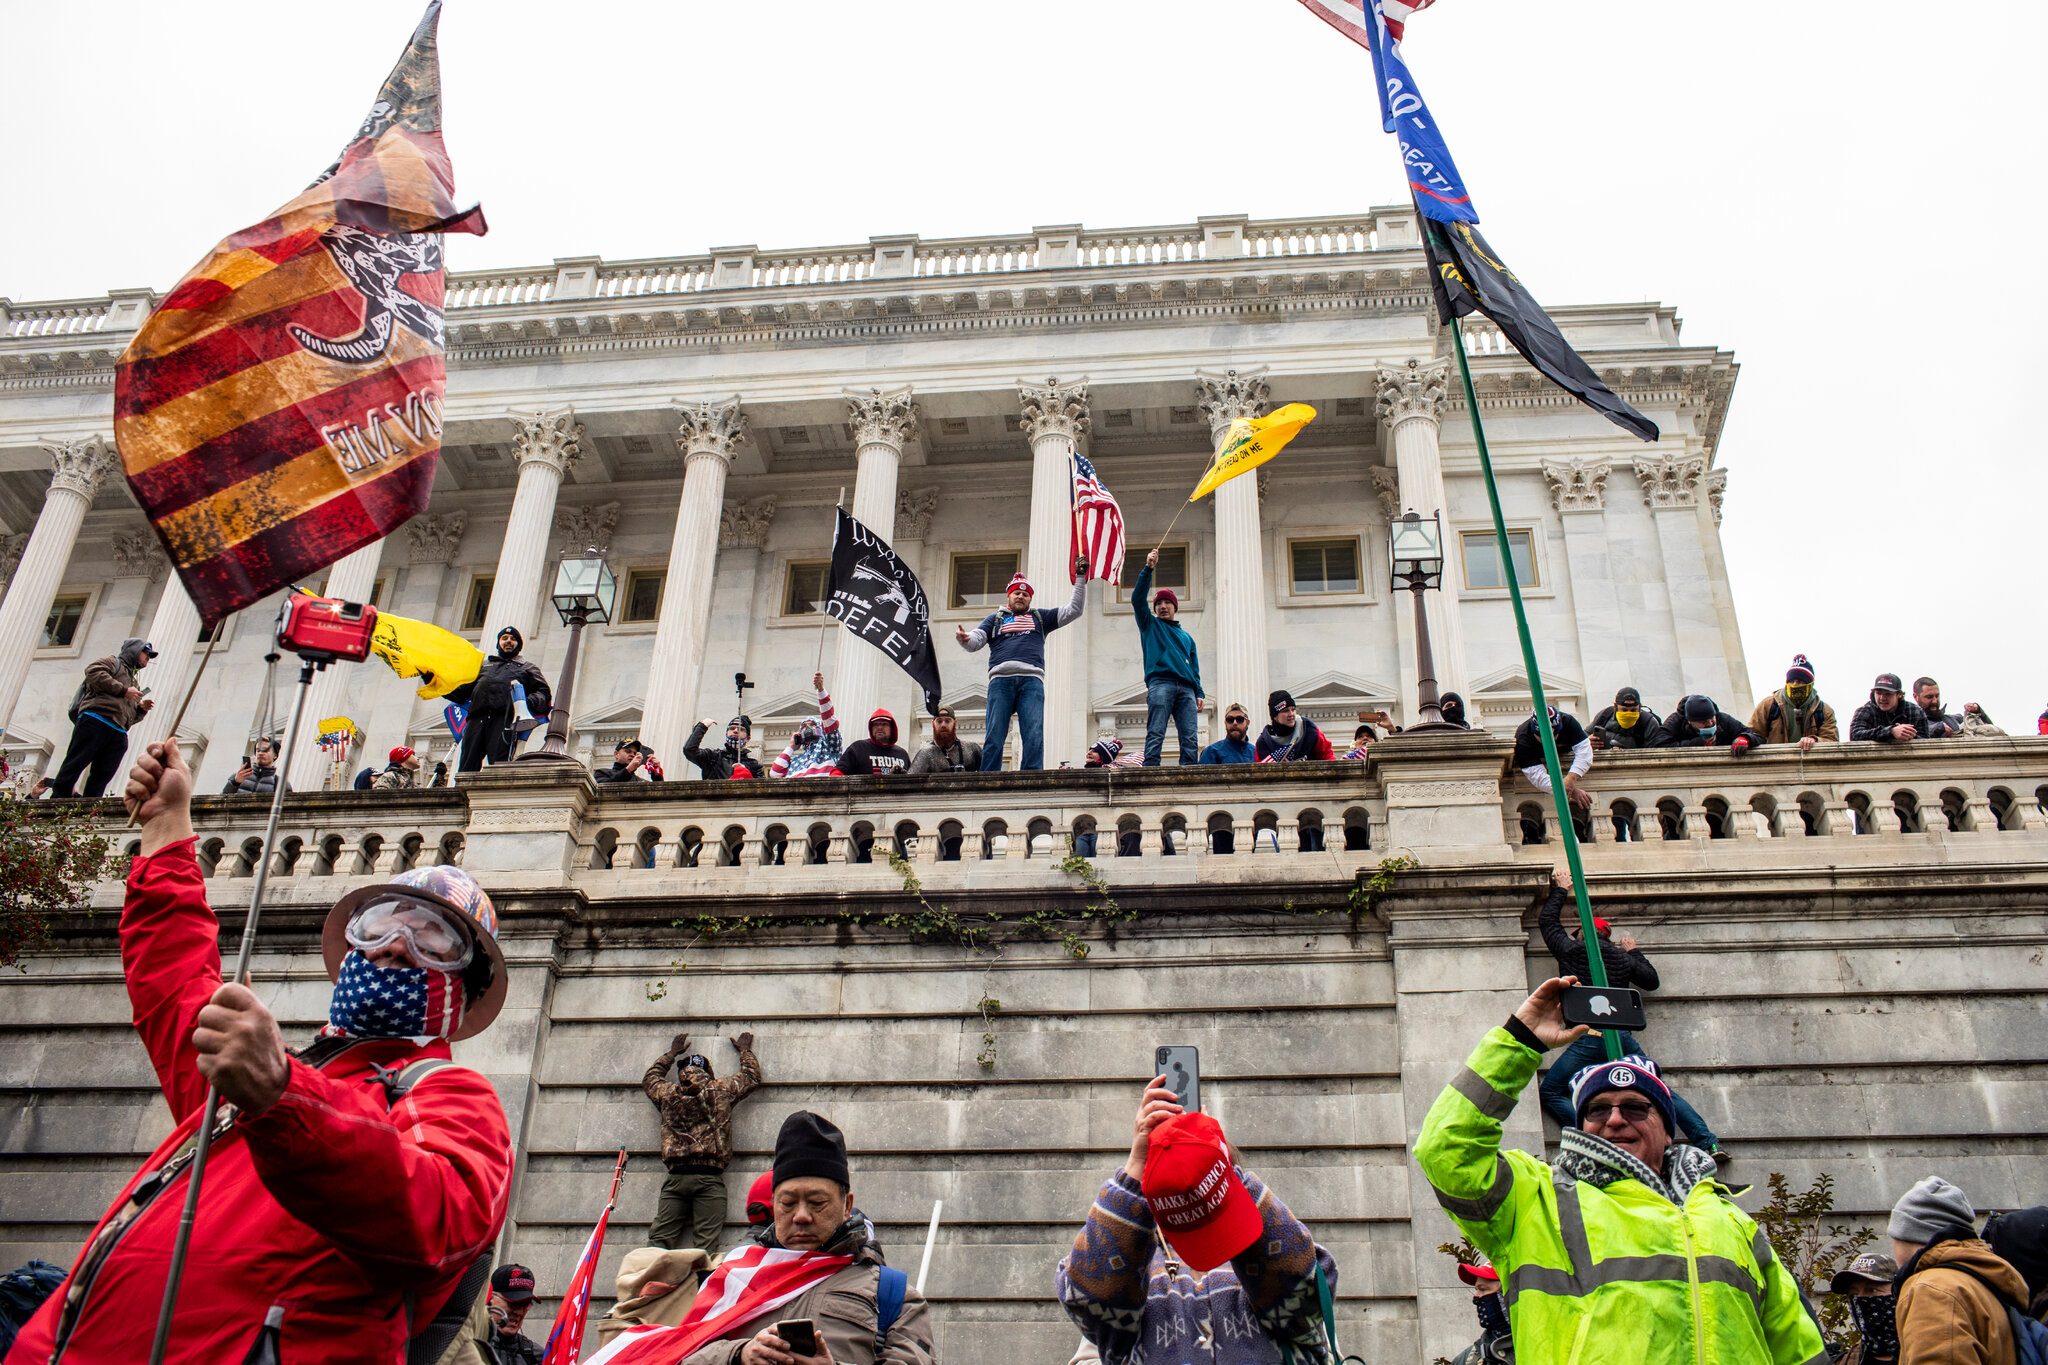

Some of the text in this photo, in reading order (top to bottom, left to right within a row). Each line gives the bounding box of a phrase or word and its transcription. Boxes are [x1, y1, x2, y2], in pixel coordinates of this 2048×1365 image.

[1240, 448, 1250, 460] ON
[1249, 442, 1263, 455] ME
[869, 755, 905, 769] TRUMP
[1614, 1071, 1630, 1083] 45
[1152, 1159, 1227, 1211] MAKE AMERICA
[1167, 1178, 1230, 1226] GREAT AGAIN
